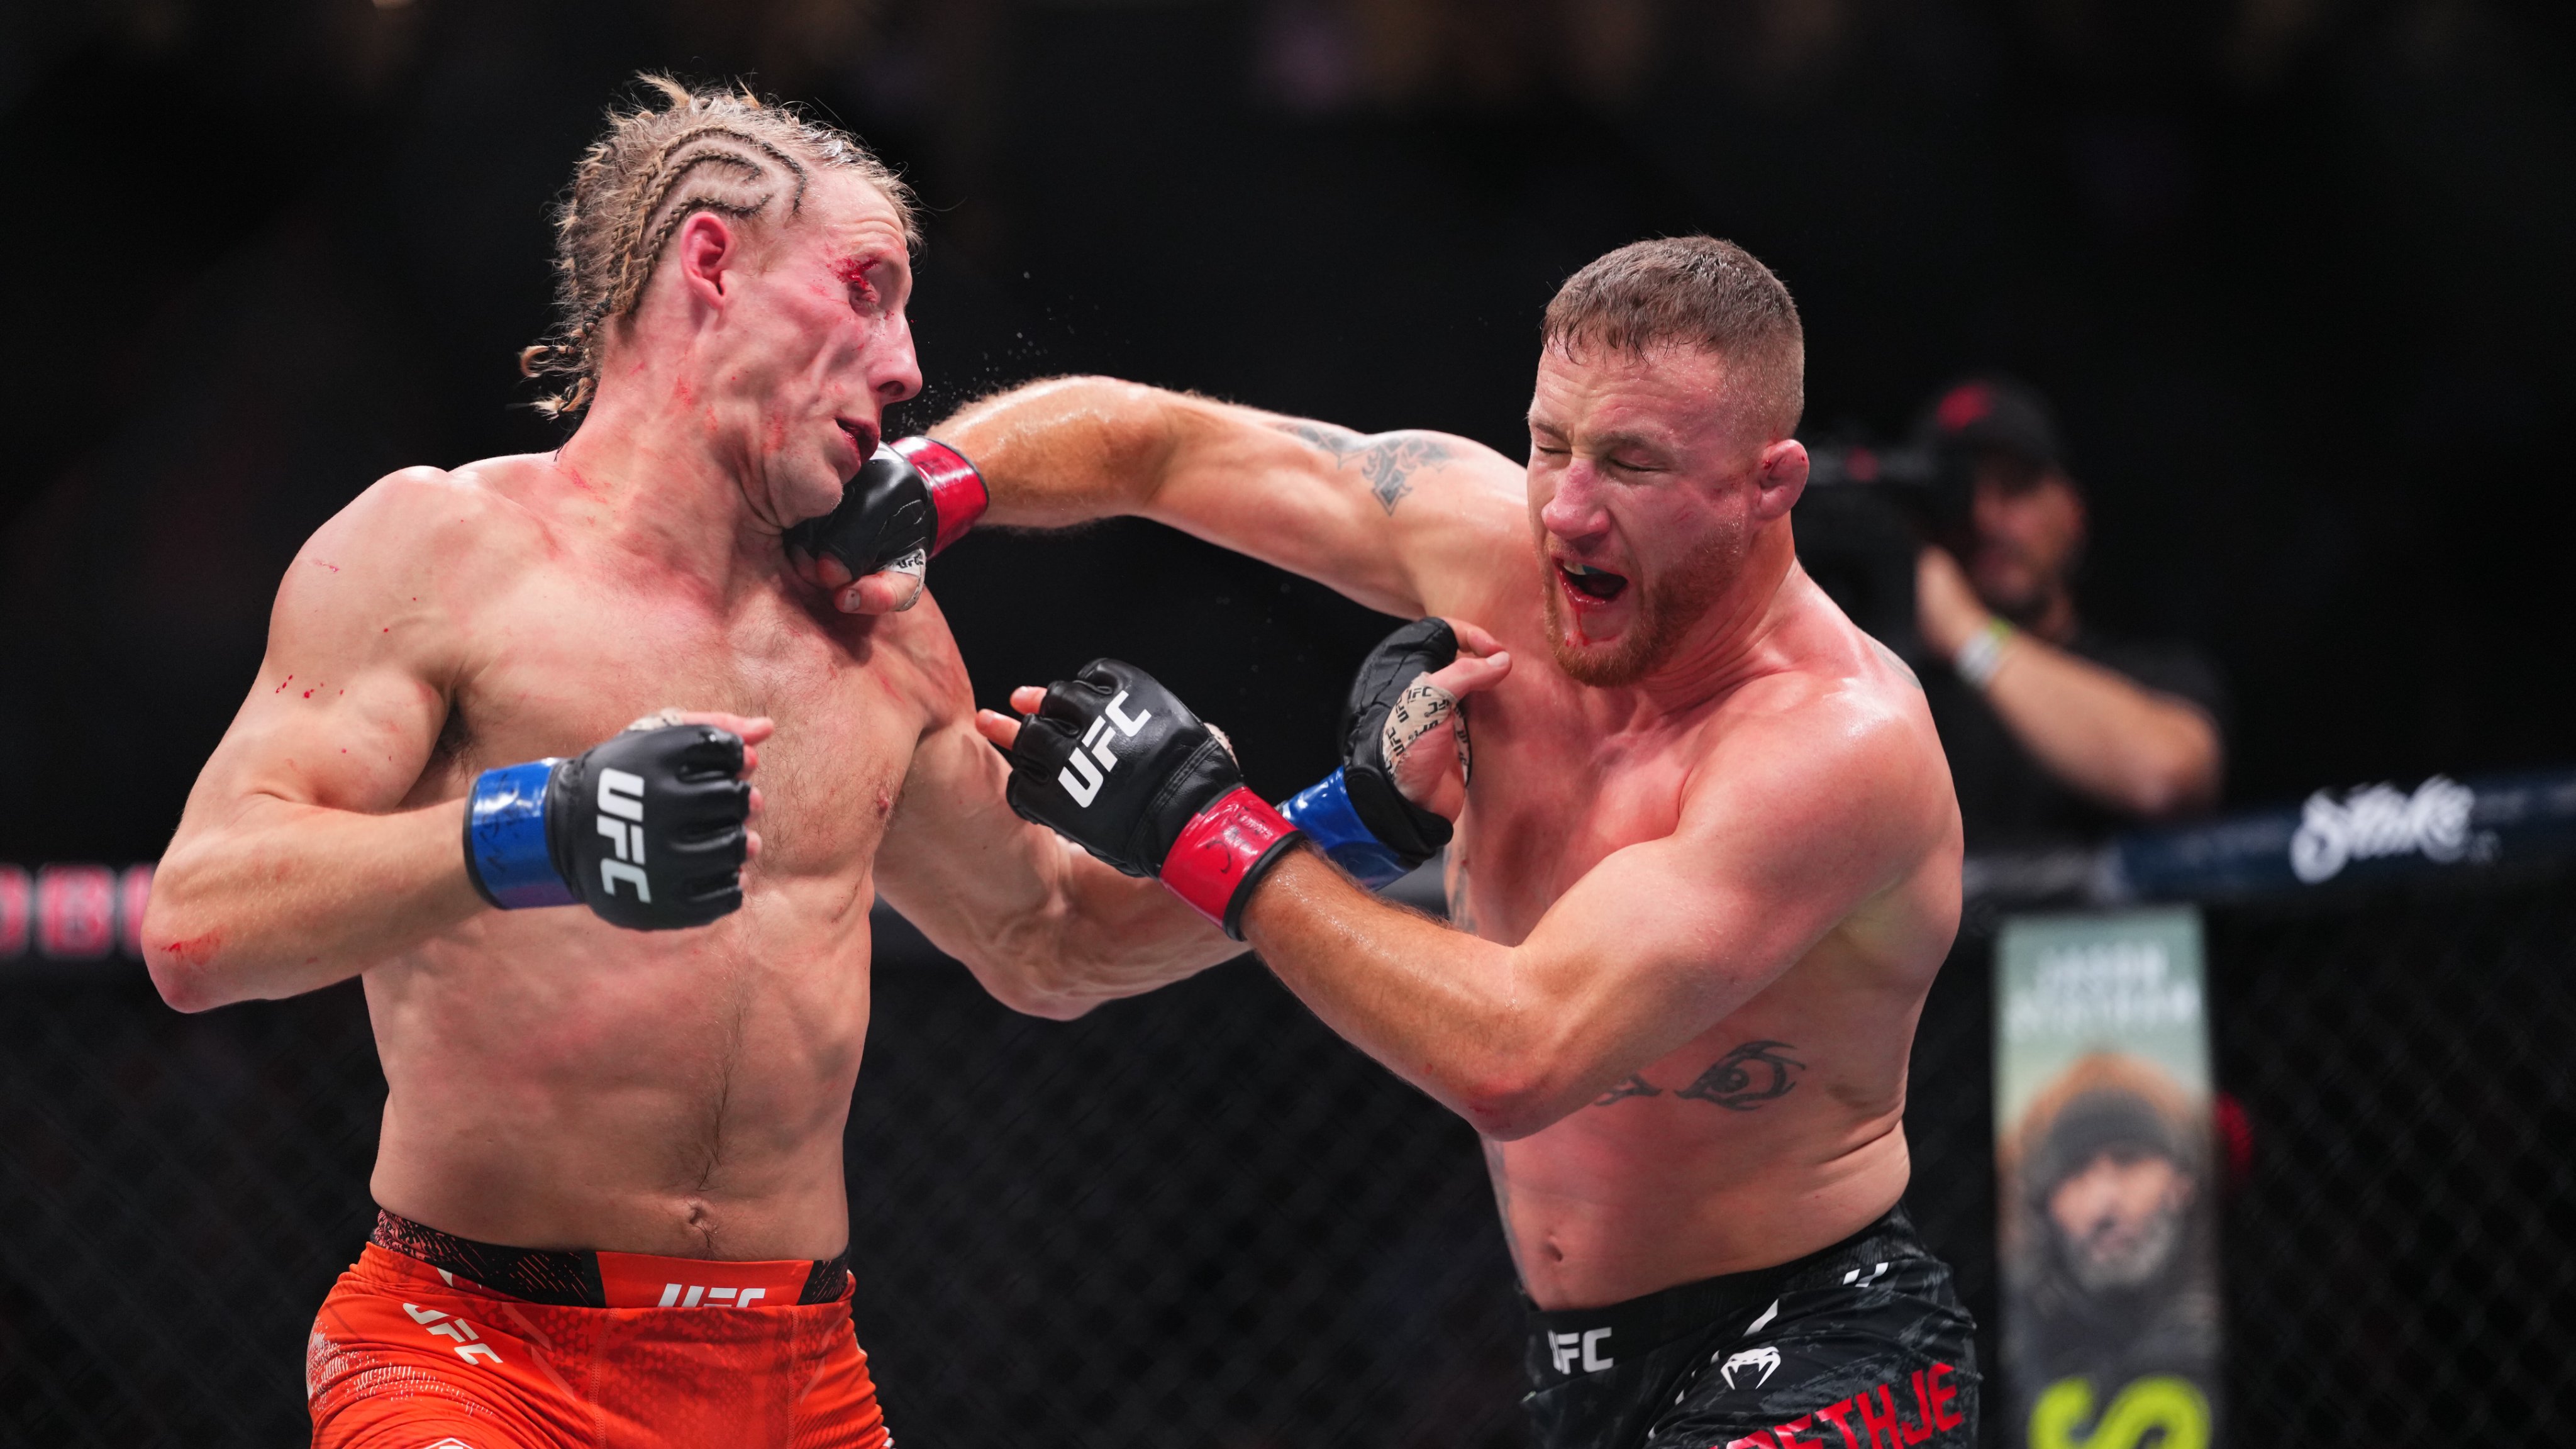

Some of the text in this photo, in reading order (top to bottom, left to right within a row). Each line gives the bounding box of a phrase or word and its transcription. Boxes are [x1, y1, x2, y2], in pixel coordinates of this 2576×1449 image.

[1058, 690, 1152, 808] UFC
[596, 767, 651, 904] UFC
[402, 1302, 503, 1365] UFC
[1706, 1362, 1963, 1449] ETHJE
